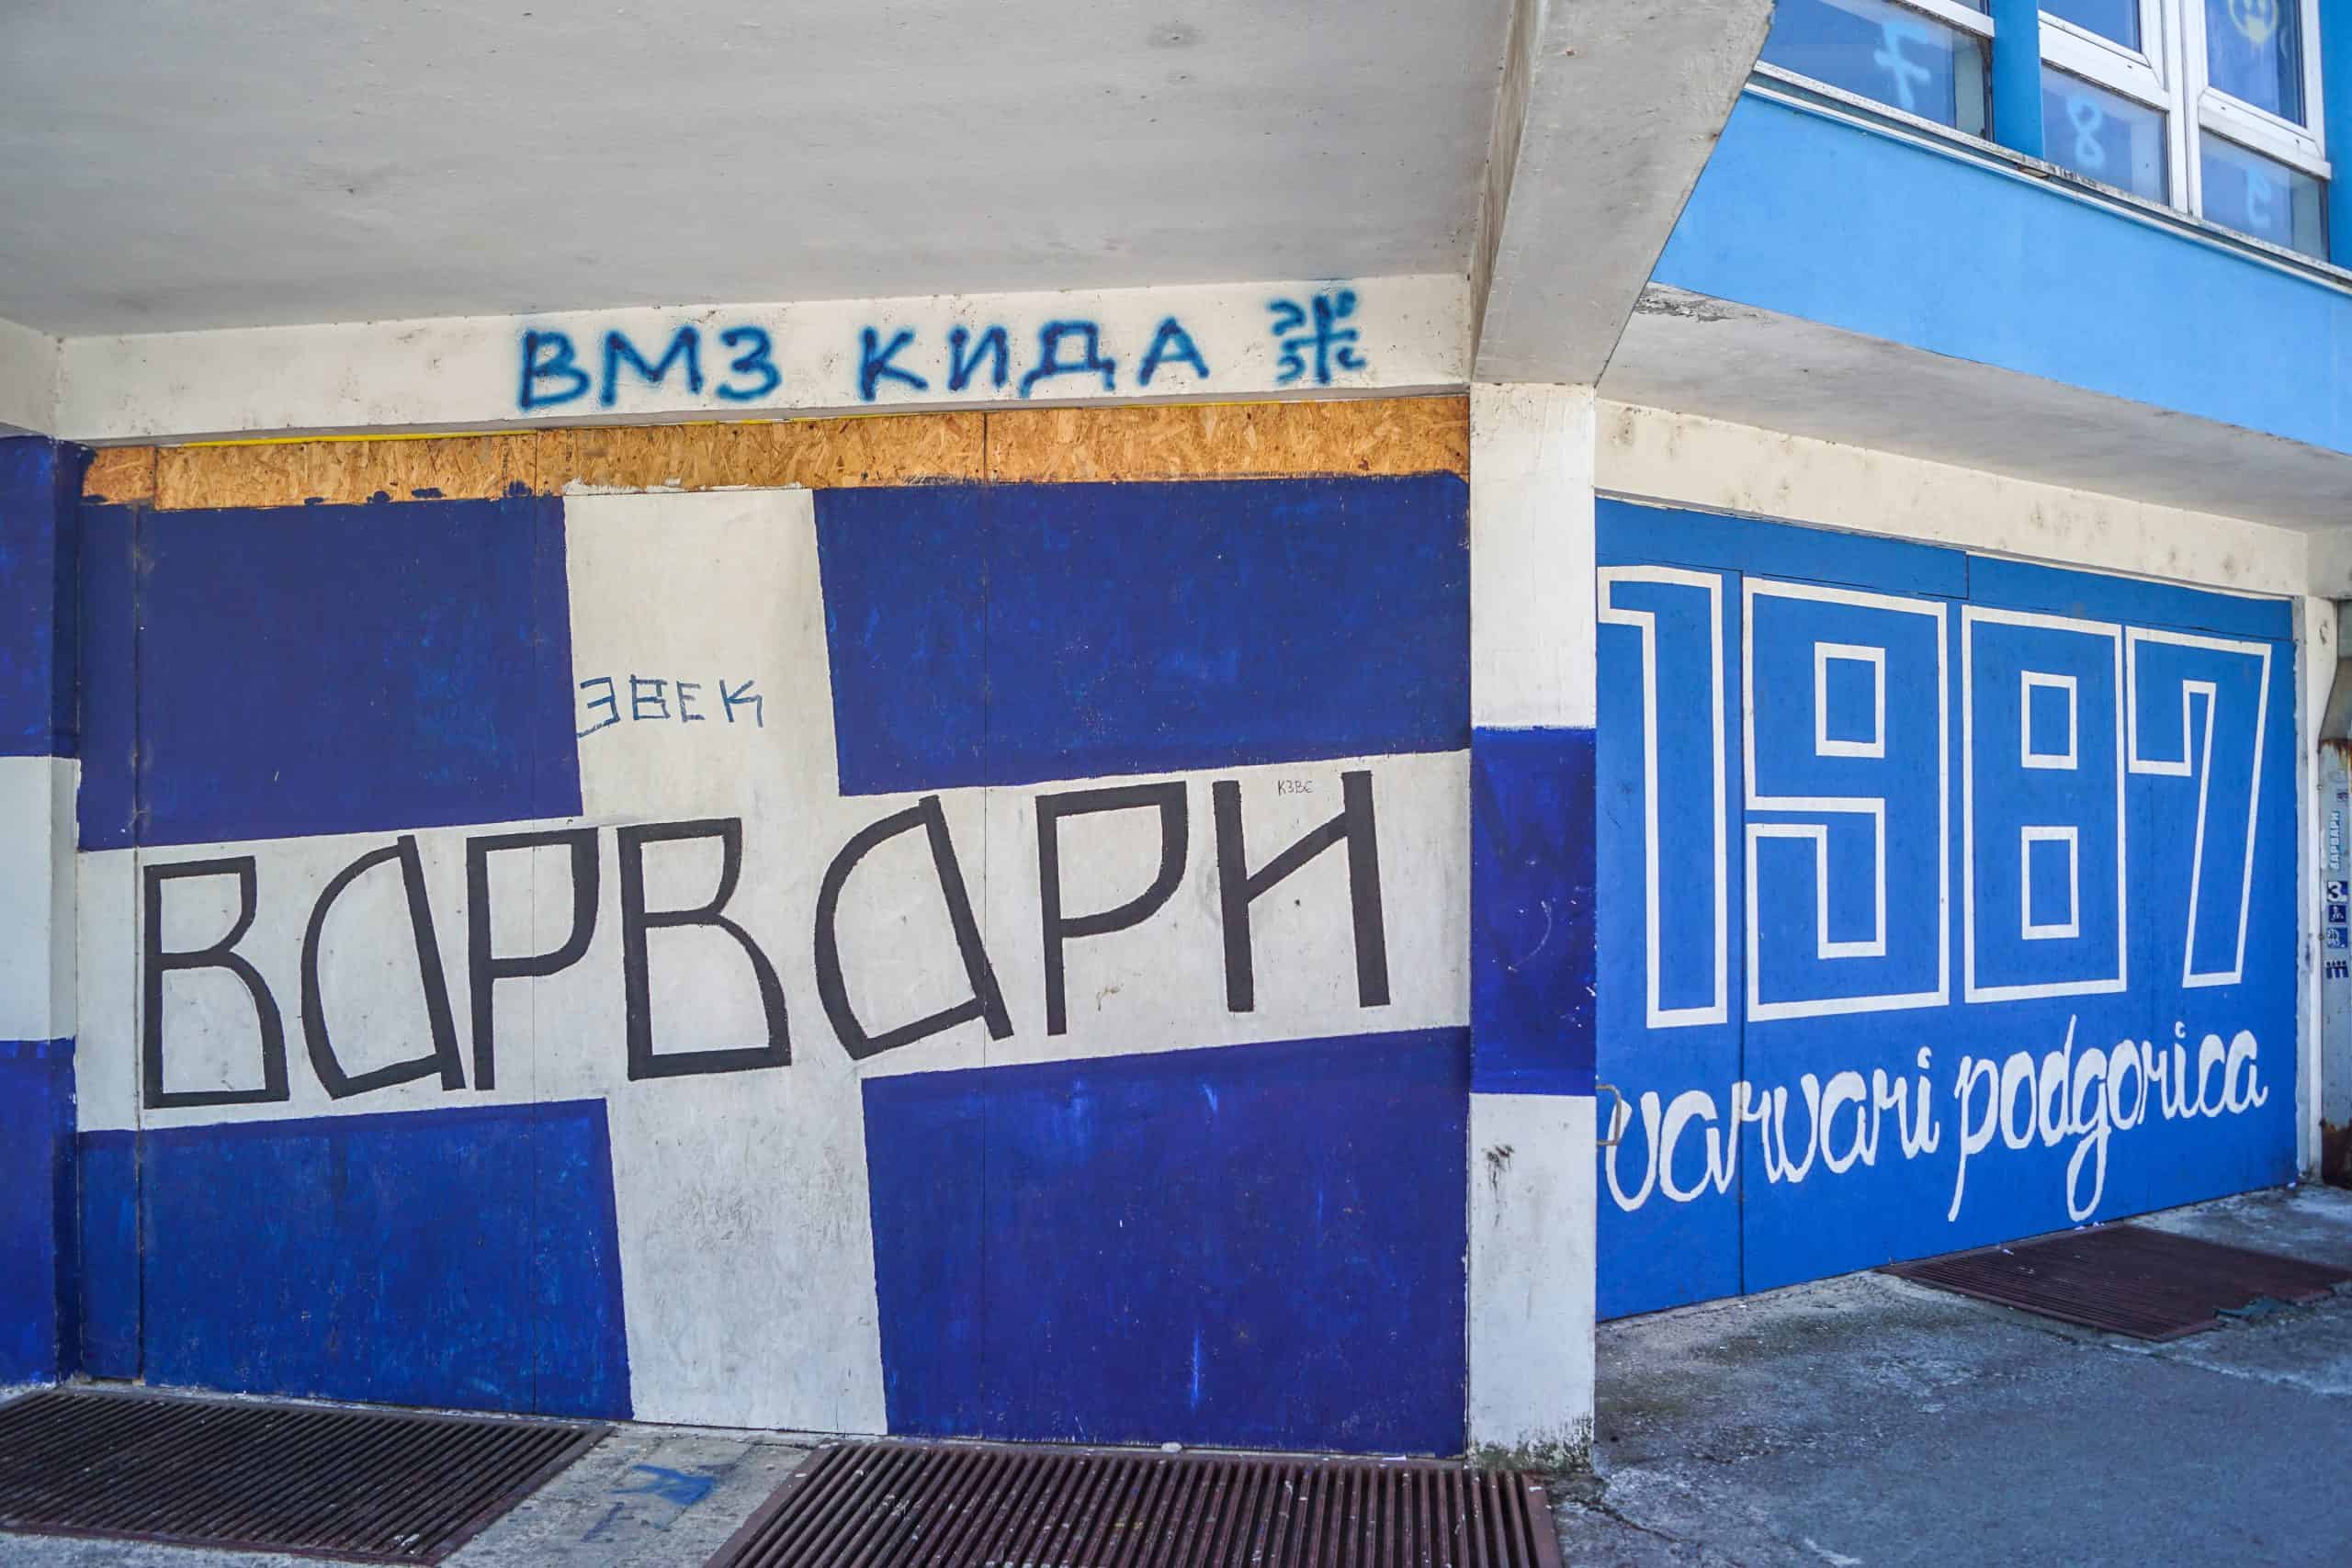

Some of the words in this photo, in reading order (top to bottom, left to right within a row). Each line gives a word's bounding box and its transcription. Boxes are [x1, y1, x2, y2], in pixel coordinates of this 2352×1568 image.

[856, 315, 1210, 404] КИДА
[1597, 565, 2273, 1029] 1987
[1948, 1015, 2268, 1223] podgorica
